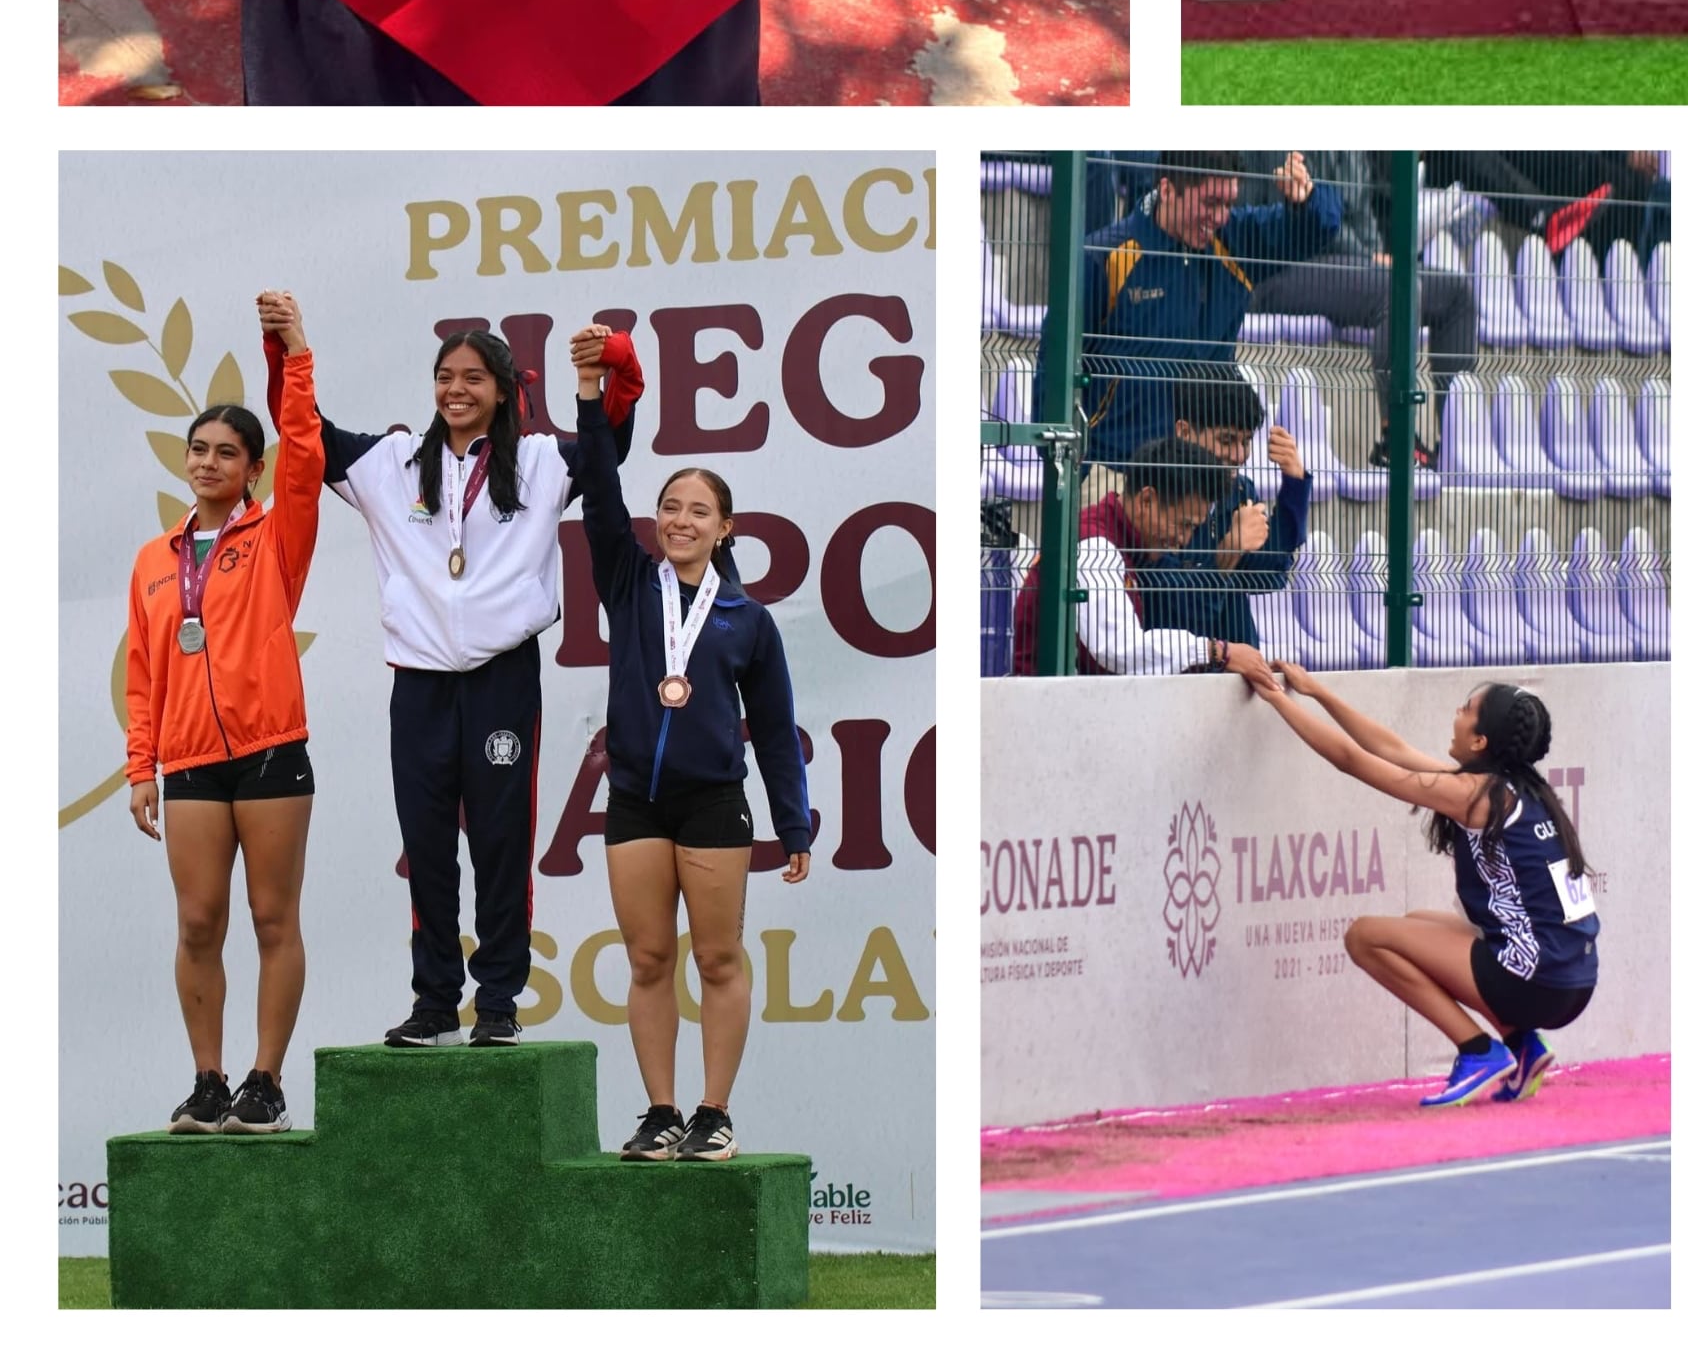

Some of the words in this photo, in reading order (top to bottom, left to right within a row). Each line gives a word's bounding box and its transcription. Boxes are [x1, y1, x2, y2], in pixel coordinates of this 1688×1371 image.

[1231, 826, 1386, 904] TLAXCALA
[1245, 925, 1270, 948] UNA
[1274, 921, 1316, 946] NUEVA
[1011, 938, 1053, 957] NACIONAL
[1055, 936, 1069, 953] DE
[1007, 962, 1036, 981] FÍSICA
[1037, 963, 1043, 979] Y
[1044, 959, 1083, 978] DEPORTE
[1274, 957, 1301, 979] 2021
[1318, 954, 1346, 976] 2027
[830, 1210, 872, 1225] Feliz
